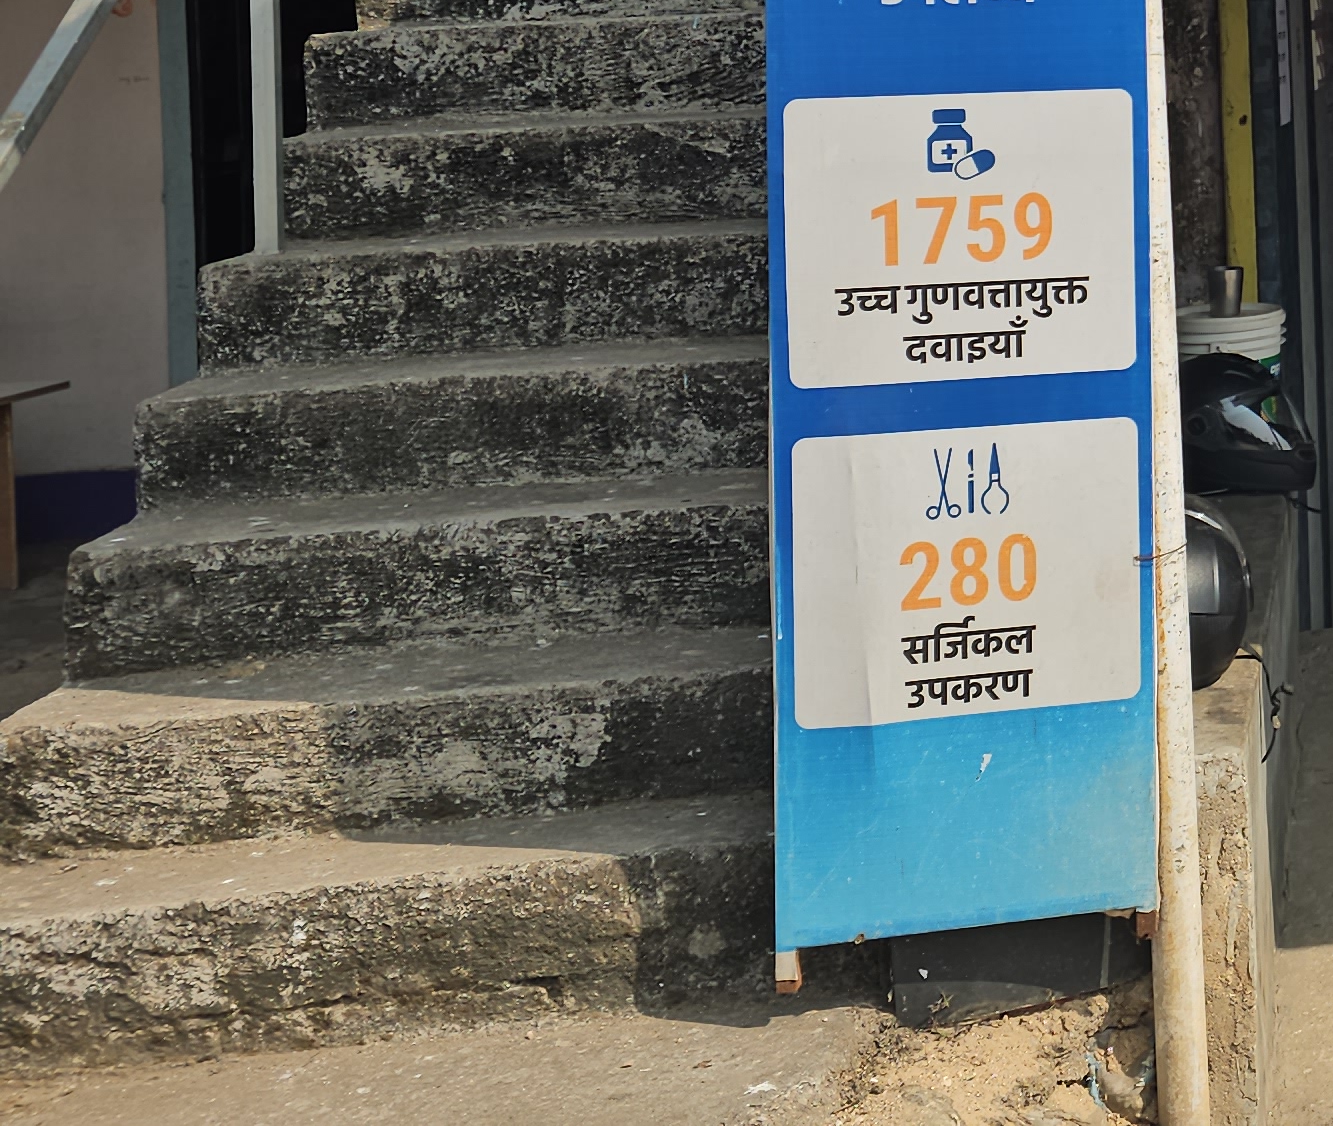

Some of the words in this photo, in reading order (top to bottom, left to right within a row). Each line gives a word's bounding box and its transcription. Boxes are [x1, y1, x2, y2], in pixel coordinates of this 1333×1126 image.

[871, 192, 1053, 267] 1759
[835, 285, 902, 317] उच्च
[904, 276, 1089, 325] गुणवत्तायुक्त
[903, 315, 1029, 364] दवाइयाँ
[899, 533, 1038, 611] 280
[901, 616, 1037, 666] सर्जिकल
[904, 668, 1034, 709] उपकरण
